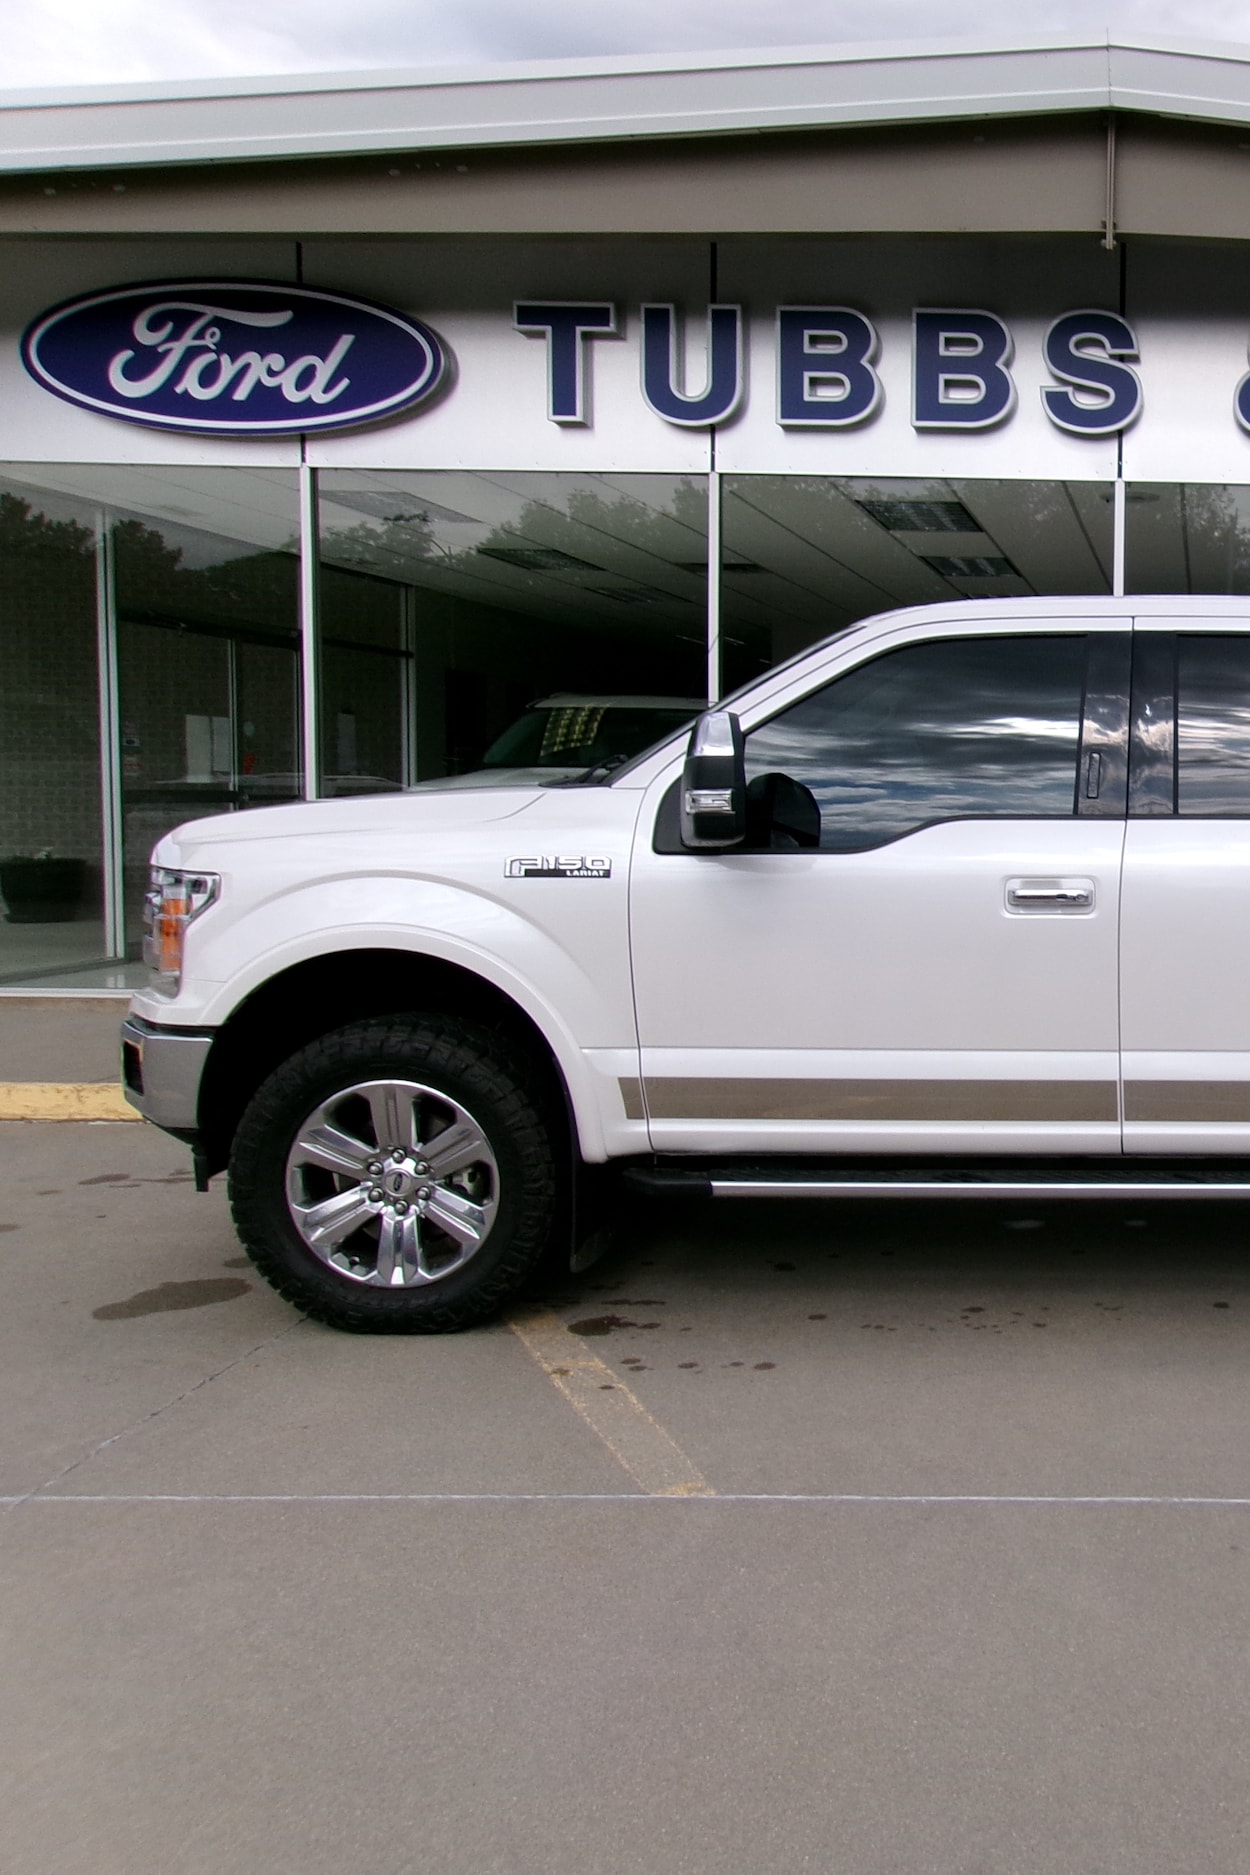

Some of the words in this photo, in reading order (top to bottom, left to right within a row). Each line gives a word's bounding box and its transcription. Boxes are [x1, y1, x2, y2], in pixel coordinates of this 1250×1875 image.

[107, 302, 355, 404] Ford
[512, 302, 1144, 434] TUBBS
[566, 869, 605, 877] LARIAT
